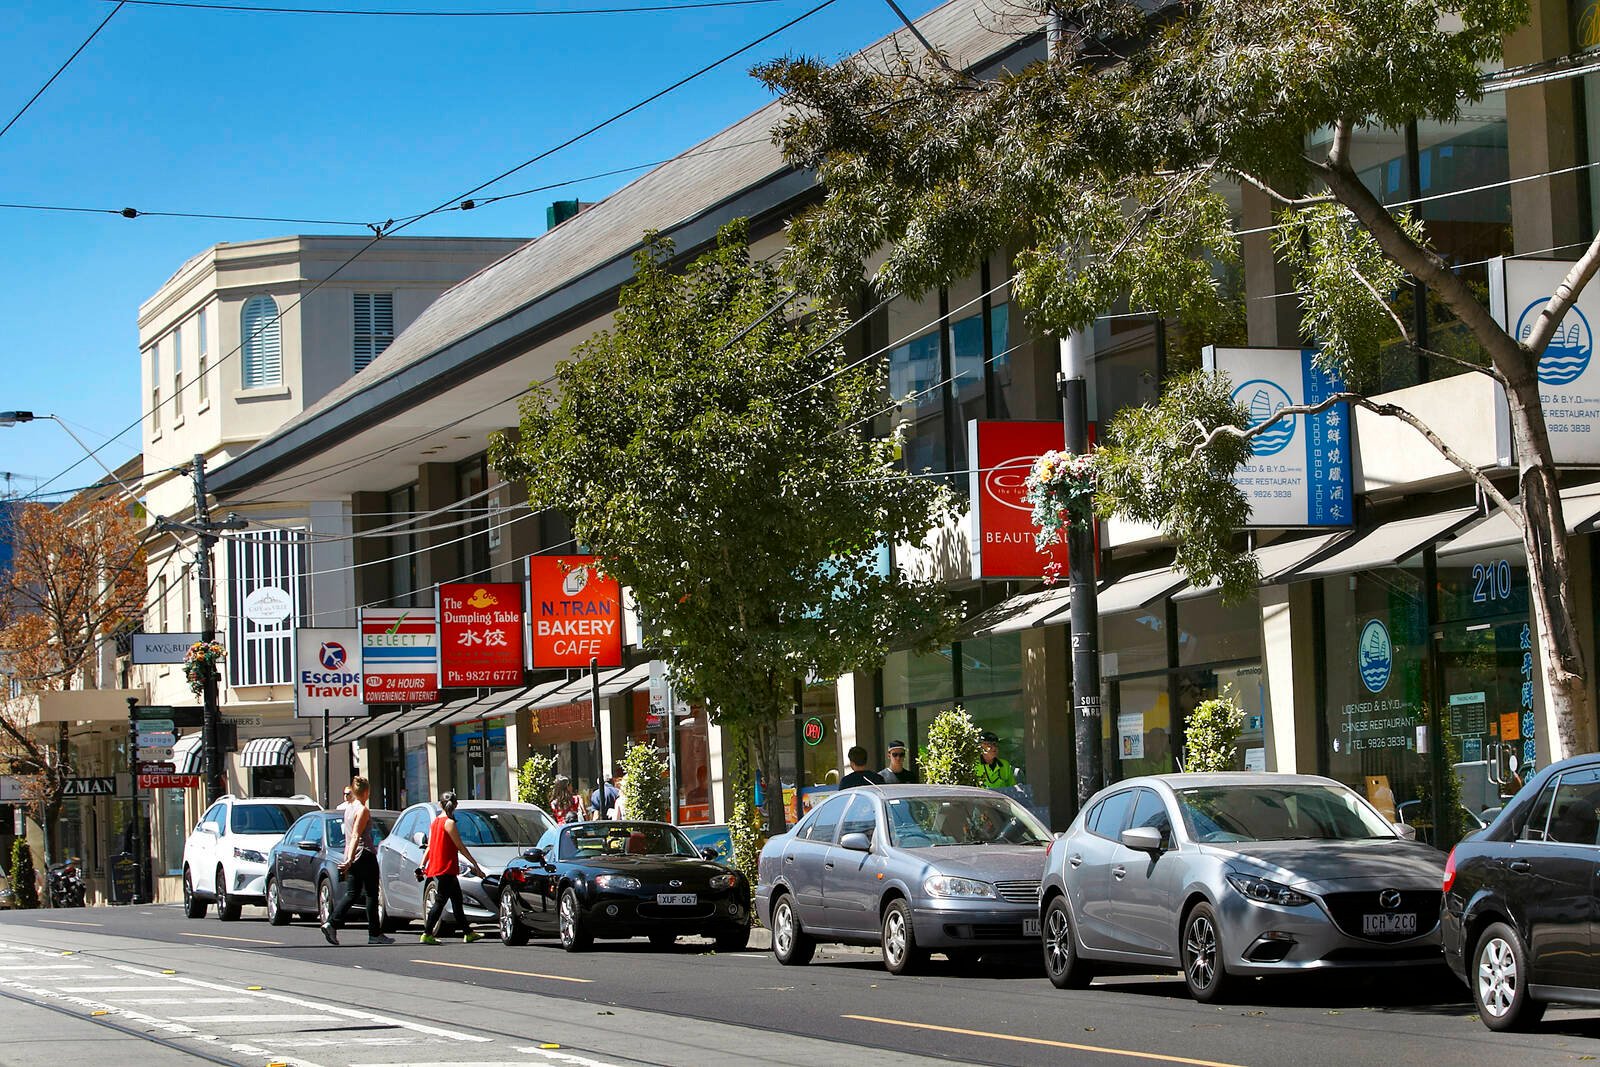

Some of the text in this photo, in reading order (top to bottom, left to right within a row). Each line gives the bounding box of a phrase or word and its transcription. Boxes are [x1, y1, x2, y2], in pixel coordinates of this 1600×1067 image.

[1549, 409, 1600, 418] RESTAURANT
[1311, 395, 1321, 446] SFOOD
[1548, 424, 1591, 433] 9826 3838
[1259, 464, 1265, 473] &
[1255, 478, 1302, 486] RESTAURANT
[1253, 490, 1272, 498] 9826
[1273, 490, 1292, 498] 3838
[1314, 484, 1324, 521] HOUSE
[1472, 559, 1511, 603] 210
[444, 597, 463, 609] The
[444, 611, 519, 626] Dumpling Table
[538, 620, 615, 636] BAKERY
[367, 635, 432, 646] SELECT 7
[457, 629, 508, 647] 水饺
[554, 640, 602, 656] CAFE
[448, 670, 518, 681] Ph: 9827 6777
[386, 679, 396, 689] 24
[397, 679, 425, 689] HOURS
[305, 685, 358, 697] Travel
[1373, 701, 1380, 711] &
[1369, 717, 1415, 731] RESTAURANT
[806, 723, 821, 739] OPEN
[1352, 736, 1406, 750] TEL. 9826 3838
